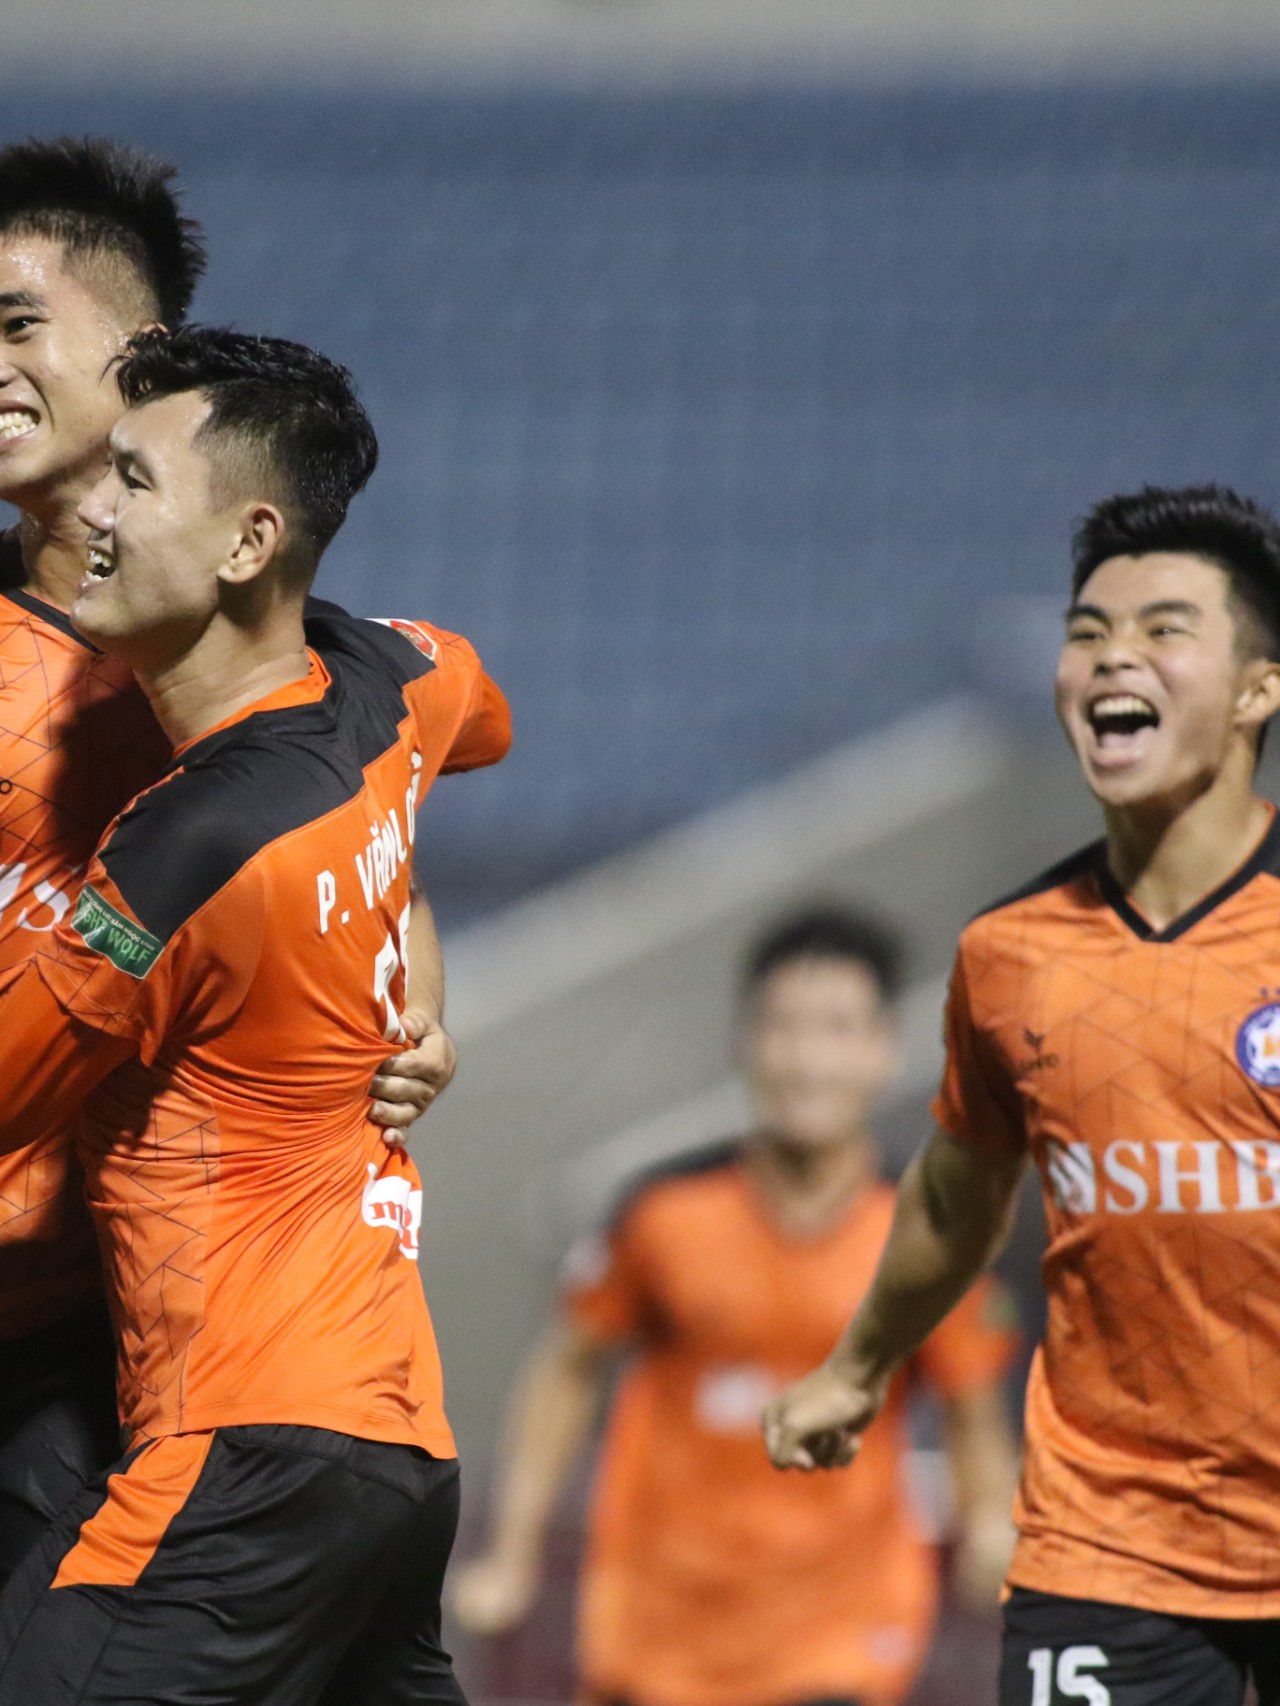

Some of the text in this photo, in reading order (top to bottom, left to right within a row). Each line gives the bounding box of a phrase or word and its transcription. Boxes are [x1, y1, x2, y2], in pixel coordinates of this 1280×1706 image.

[317, 870, 350, 934] P.
[355, 820, 397, 910] VĂN
[108, 927, 152, 964] WOLF
[1027, 1645, 1111, 1706] 15
